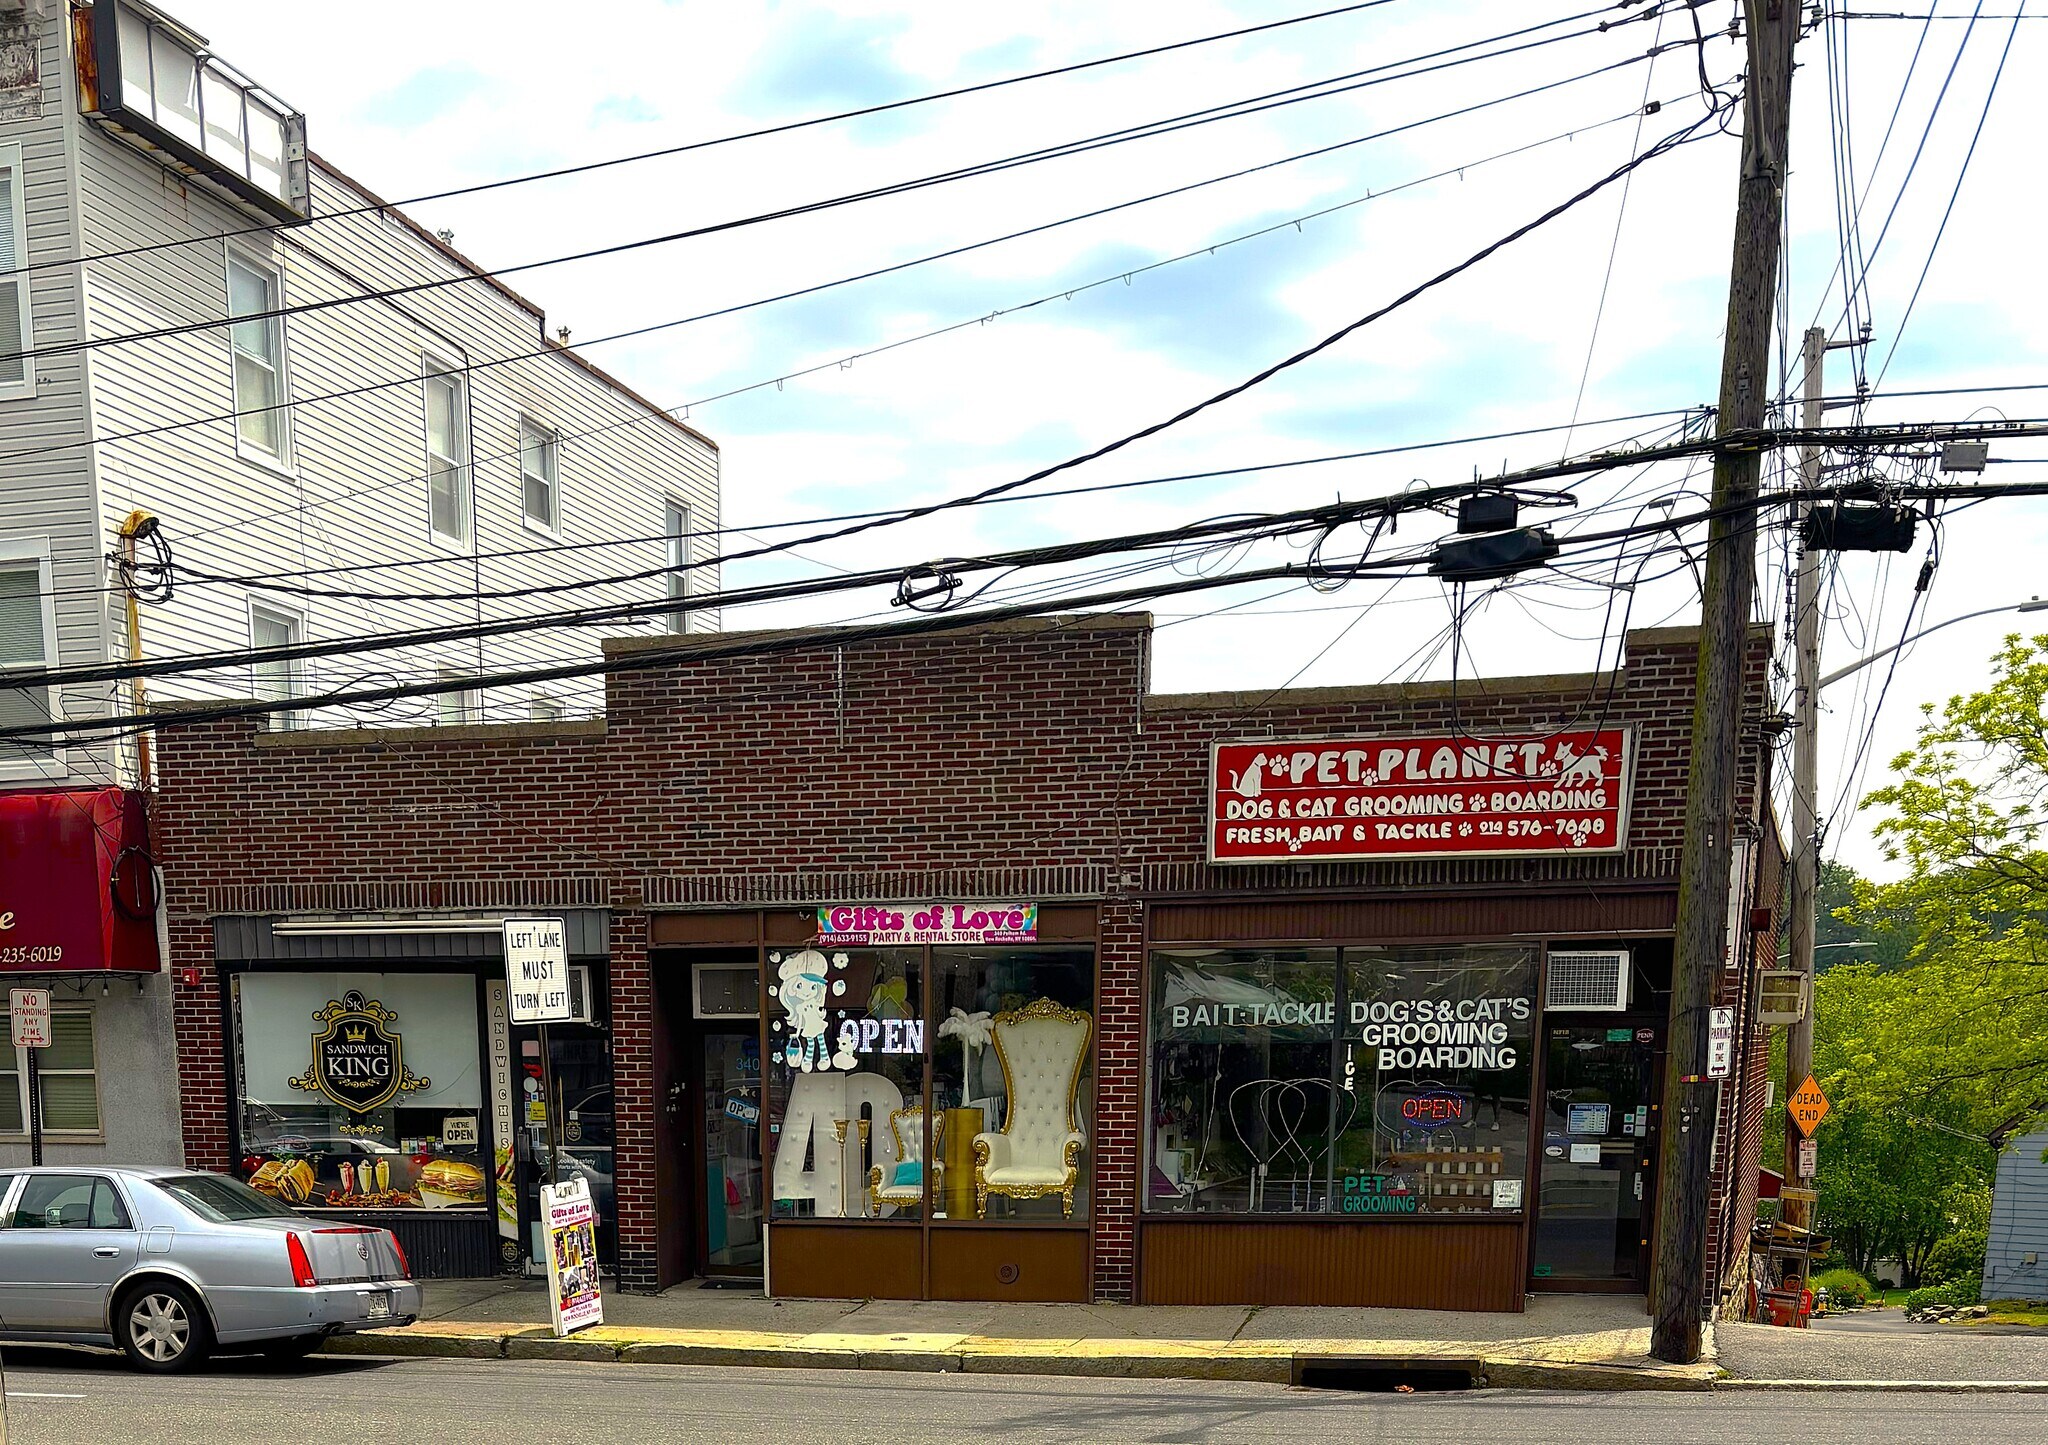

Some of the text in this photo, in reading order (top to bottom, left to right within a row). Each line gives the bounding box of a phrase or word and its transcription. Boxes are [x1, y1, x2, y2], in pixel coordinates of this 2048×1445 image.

[1290, 743, 1546, 784] PET PLANET
[1226, 788, 1606, 819] DOG & CAT GROOMING BOARDING
[1226, 818, 1605, 844] FRESH BAIT & TACKLE 914 576-7648
[830, 904, 1025, 931] Gifts of Love
[510, 932, 561, 949] LEFT LANE
[873, 931, 981, 943] PARTY & RENTAL STORE
[522, 961, 554, 980] MUST
[22, 994, 37, 1006] NO
[514, 992, 565, 1009] TURN LEFT
[14, 1007, 47, 1016] STANDING
[1716, 1010, 1726, 1024] NO
[23, 1018, 38, 1026] ANY
[22, 1027, 40, 1036] TIME
[839, 1019, 924, 1054] OPEN
[1363, 1022, 1508, 1046] GROOMING
[1711, 1026, 1731, 1040] PARKING
[327, 1044, 387, 1054] SANDWICH
[1716, 1042, 1724, 1051] ANY
[327, 1056, 389, 1076] KING
[735, 1057, 760, 1071] 340
[1378, 1046, 1517, 1070] BOARDING
[493, 989, 509, 1149] SANDWICHES
[1797, 1093, 1822, 1105] DEAD
[1401, 1098, 1462, 1118] OPEN
[1799, 1109, 1818, 1121] END
[447, 1129, 474, 1141] OPEN
[1344, 1175, 1386, 1193] PET
[551, 1204, 590, 1218] Gifts of Love
[1343, 1195, 1415, 1212] GROOMING
